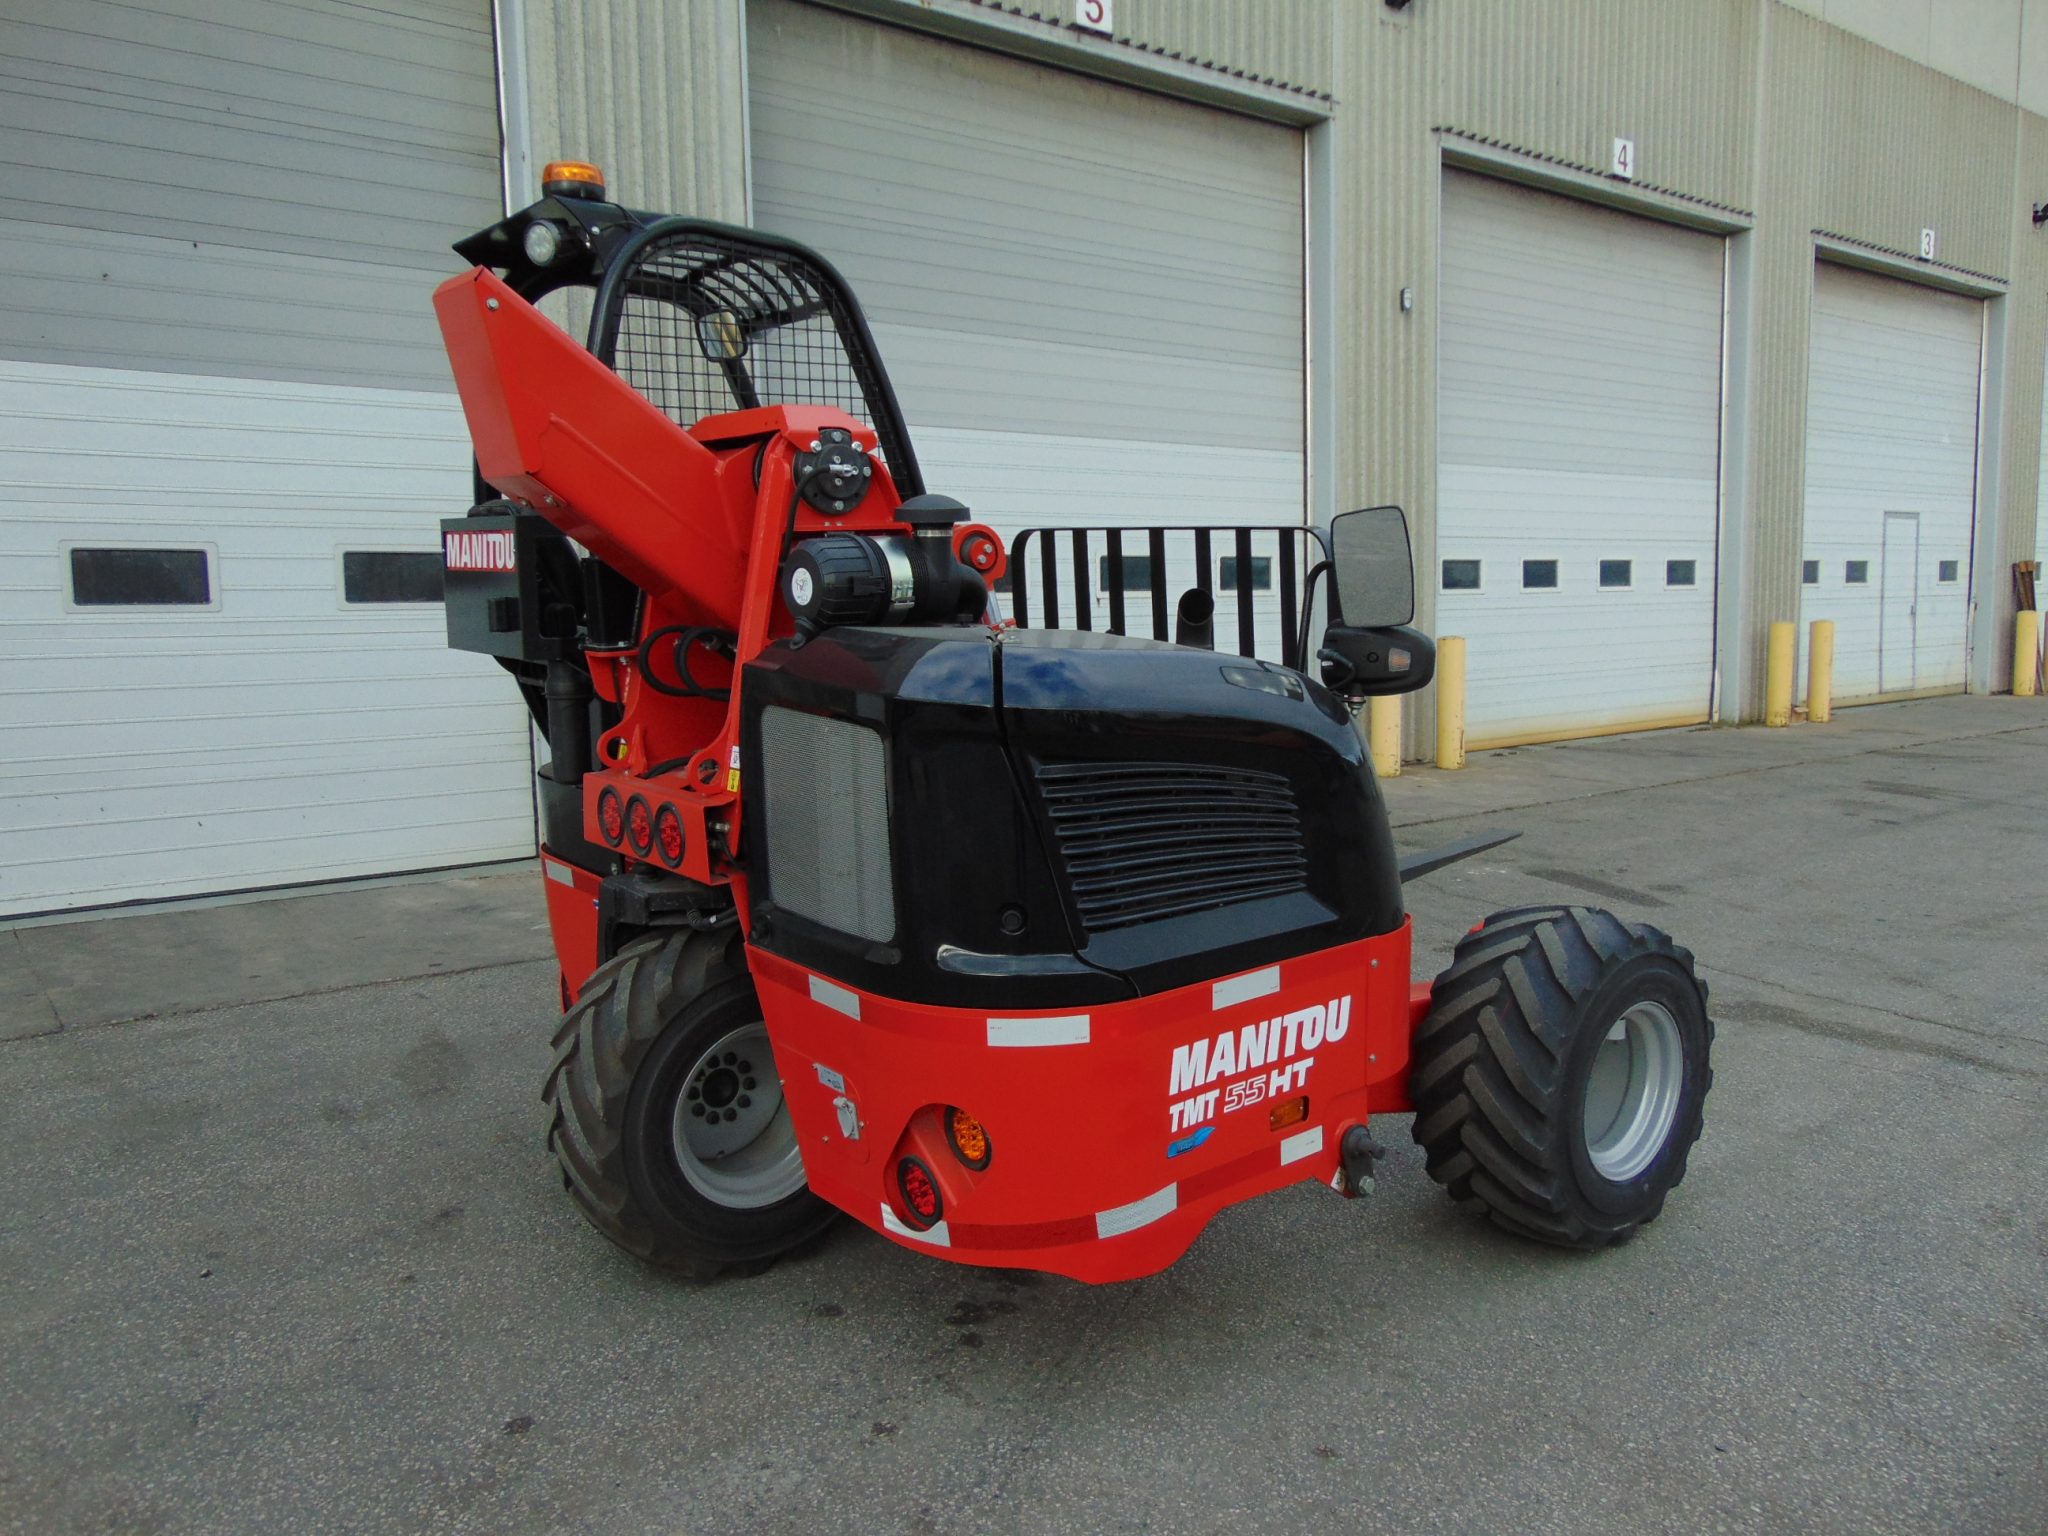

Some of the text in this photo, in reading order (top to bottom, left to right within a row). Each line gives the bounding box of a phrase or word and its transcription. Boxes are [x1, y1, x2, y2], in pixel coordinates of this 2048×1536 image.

[1085, 0, 1104, 24] 5
[1617, 143, 1628, 172] 4
[1923, 232, 1932, 256] 3
[446, 532, 515, 569] MANITOU
[1169, 995, 1352, 1096] MANITOU
[1169, 1088, 1221, 1133] TMT
